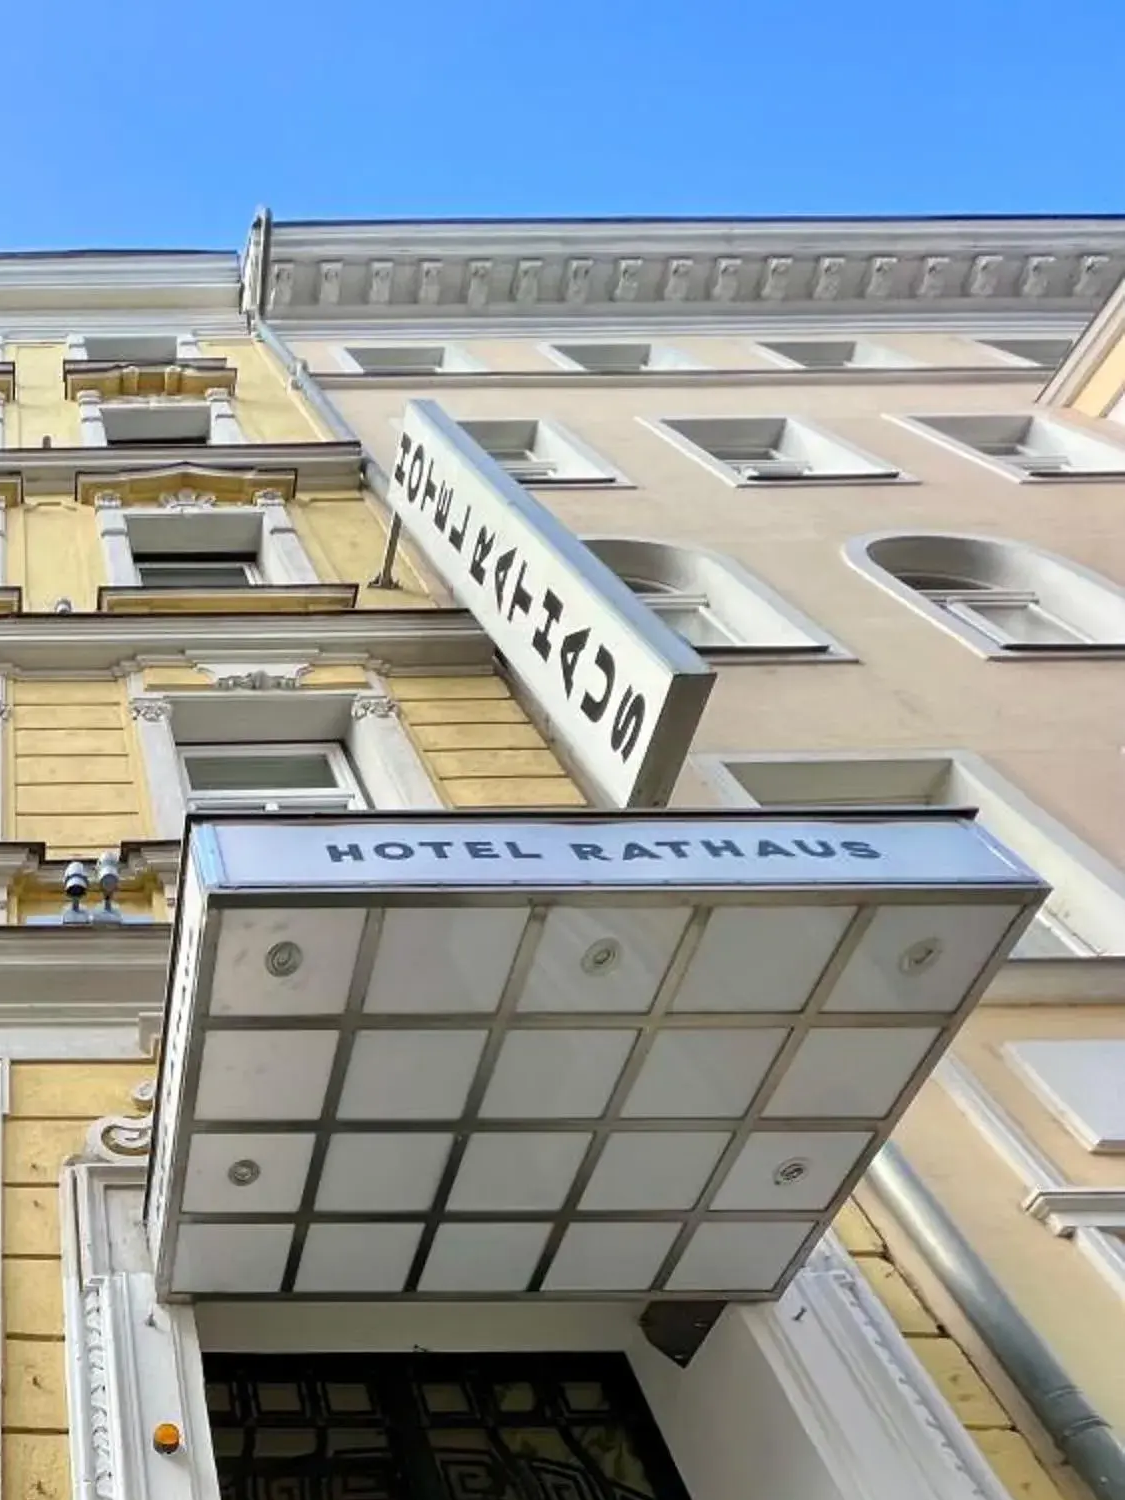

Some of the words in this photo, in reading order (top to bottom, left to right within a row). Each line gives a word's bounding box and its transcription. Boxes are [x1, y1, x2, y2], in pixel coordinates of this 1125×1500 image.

[393, 431, 472, 555] HOTEL
[469, 524, 647, 764] RATHAUS
[326, 840, 543, 863] HOTEL
[569, 839, 883, 862] RATHAUS
